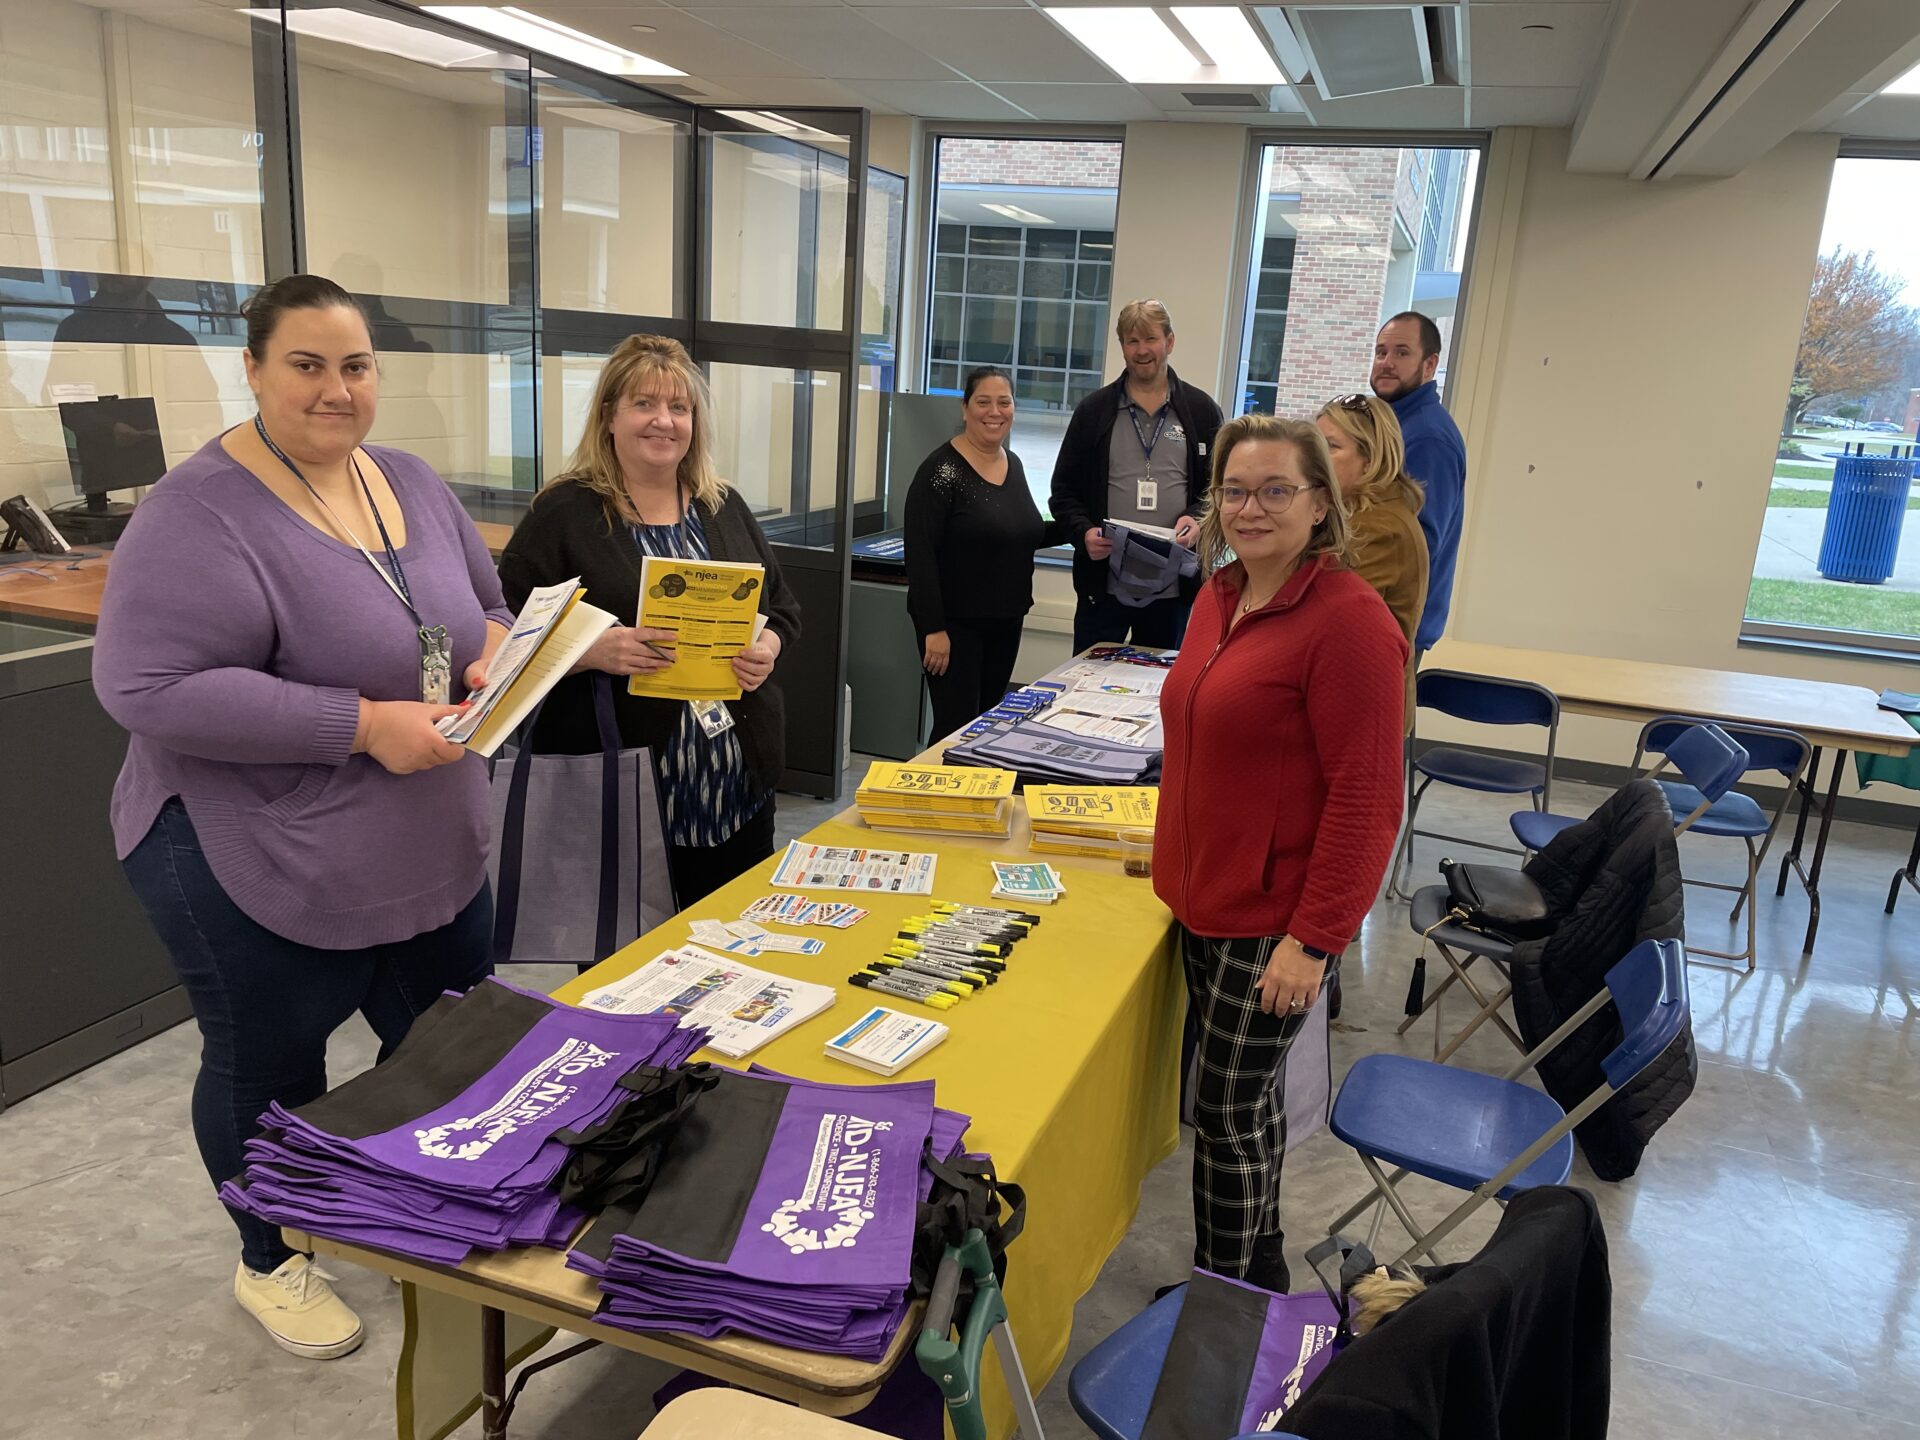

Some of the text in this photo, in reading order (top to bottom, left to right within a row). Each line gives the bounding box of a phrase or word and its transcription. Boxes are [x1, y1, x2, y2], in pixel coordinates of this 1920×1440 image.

[696, 570, 718, 581] njea
[897, 1028, 914, 1040] njea
[484, 1044, 611, 1128] AID-NJEA
[530, 1071, 548, 1090] TRUST
